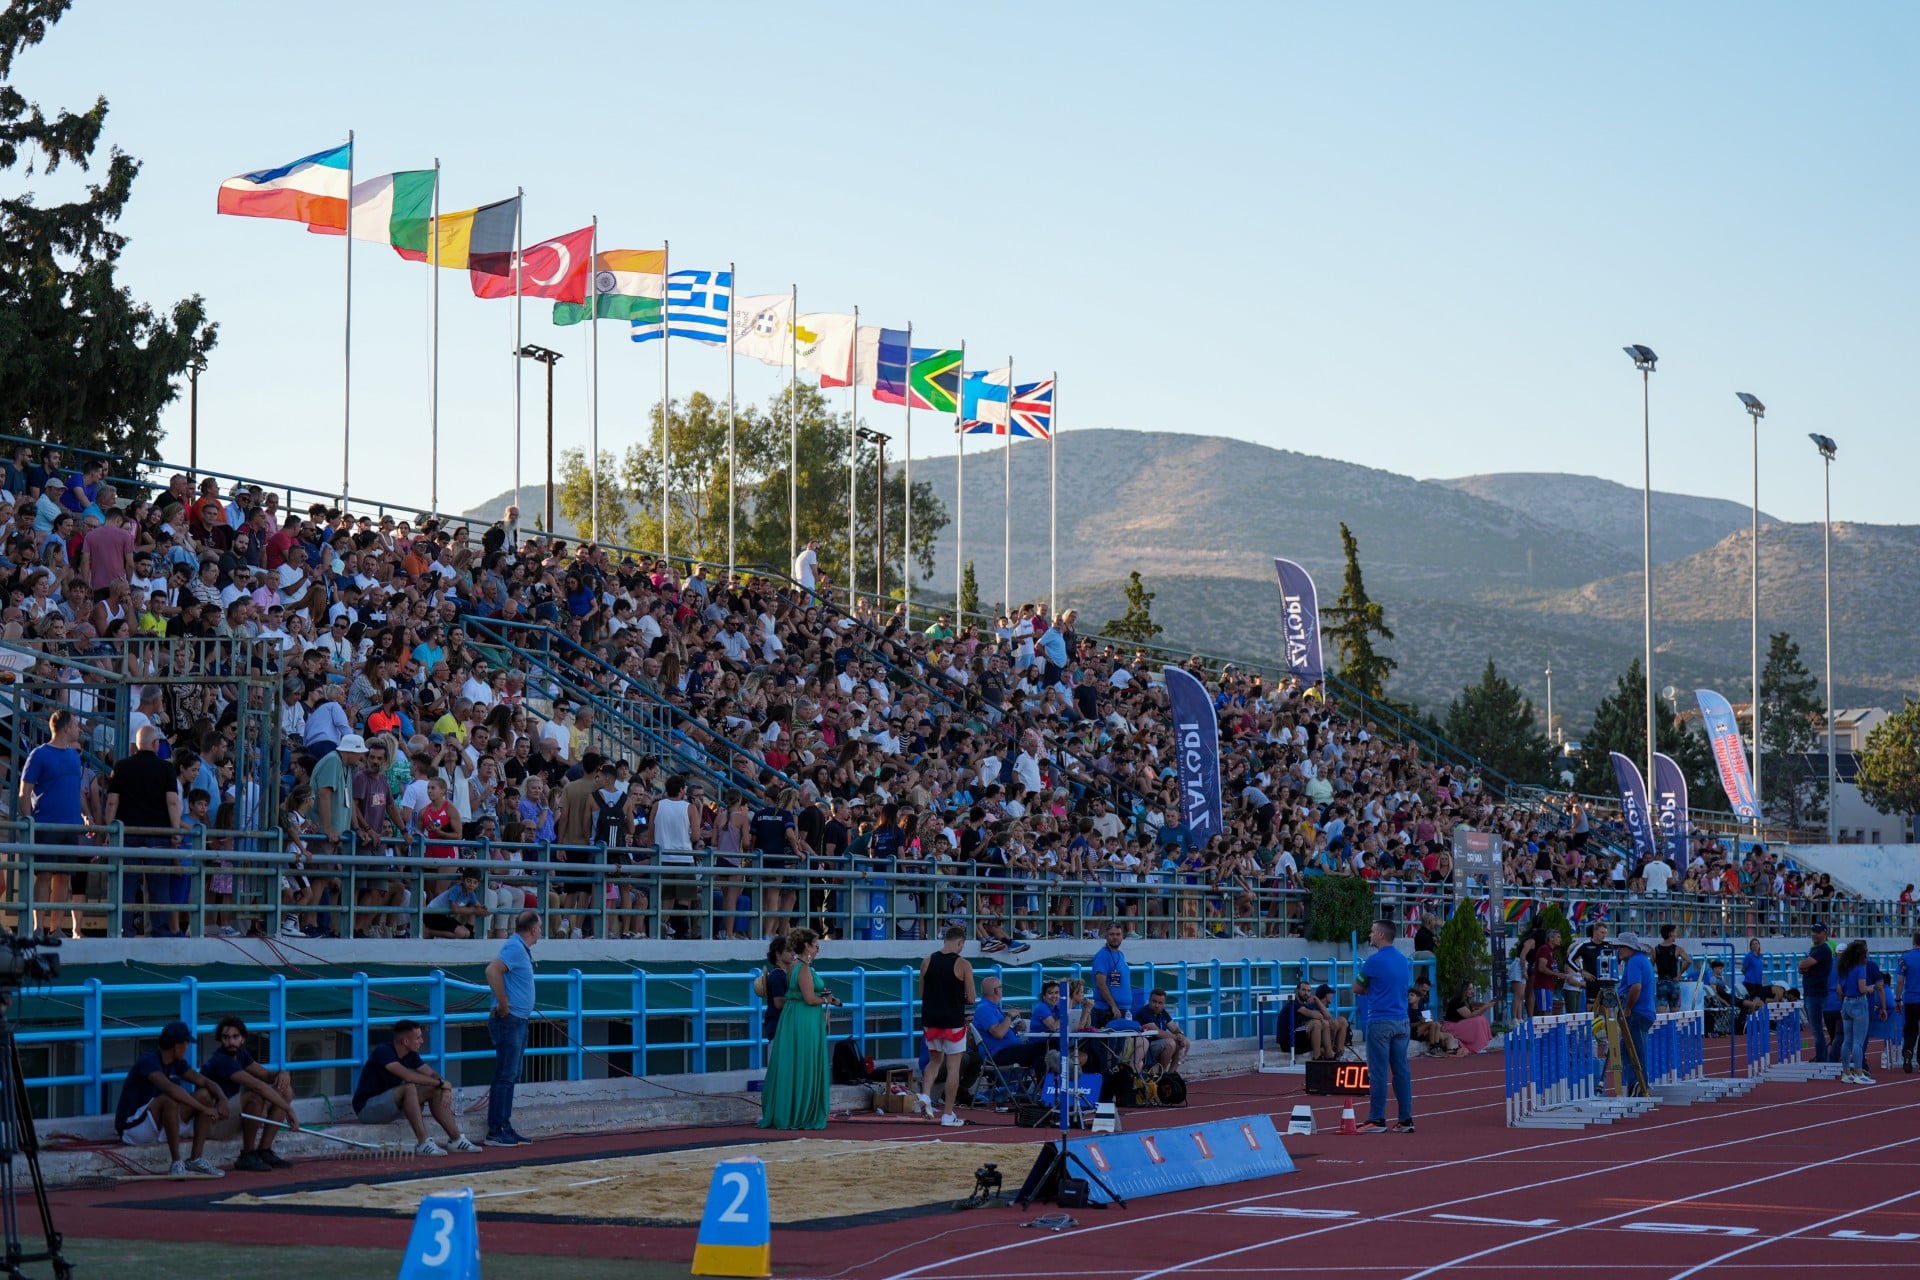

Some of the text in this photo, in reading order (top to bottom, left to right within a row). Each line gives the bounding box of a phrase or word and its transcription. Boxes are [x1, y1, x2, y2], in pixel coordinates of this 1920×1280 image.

[1713, 736, 1741, 805] INTERNATIONAL
[1726, 733, 1746, 774] MEETING
[1090, 1146, 1105, 1168] 9
[1195, 1135, 1208, 1155] 7
[717, 1171, 749, 1223] 2
[1429, 1213, 1561, 1226] 7
[422, 1208, 454, 1267] 3
